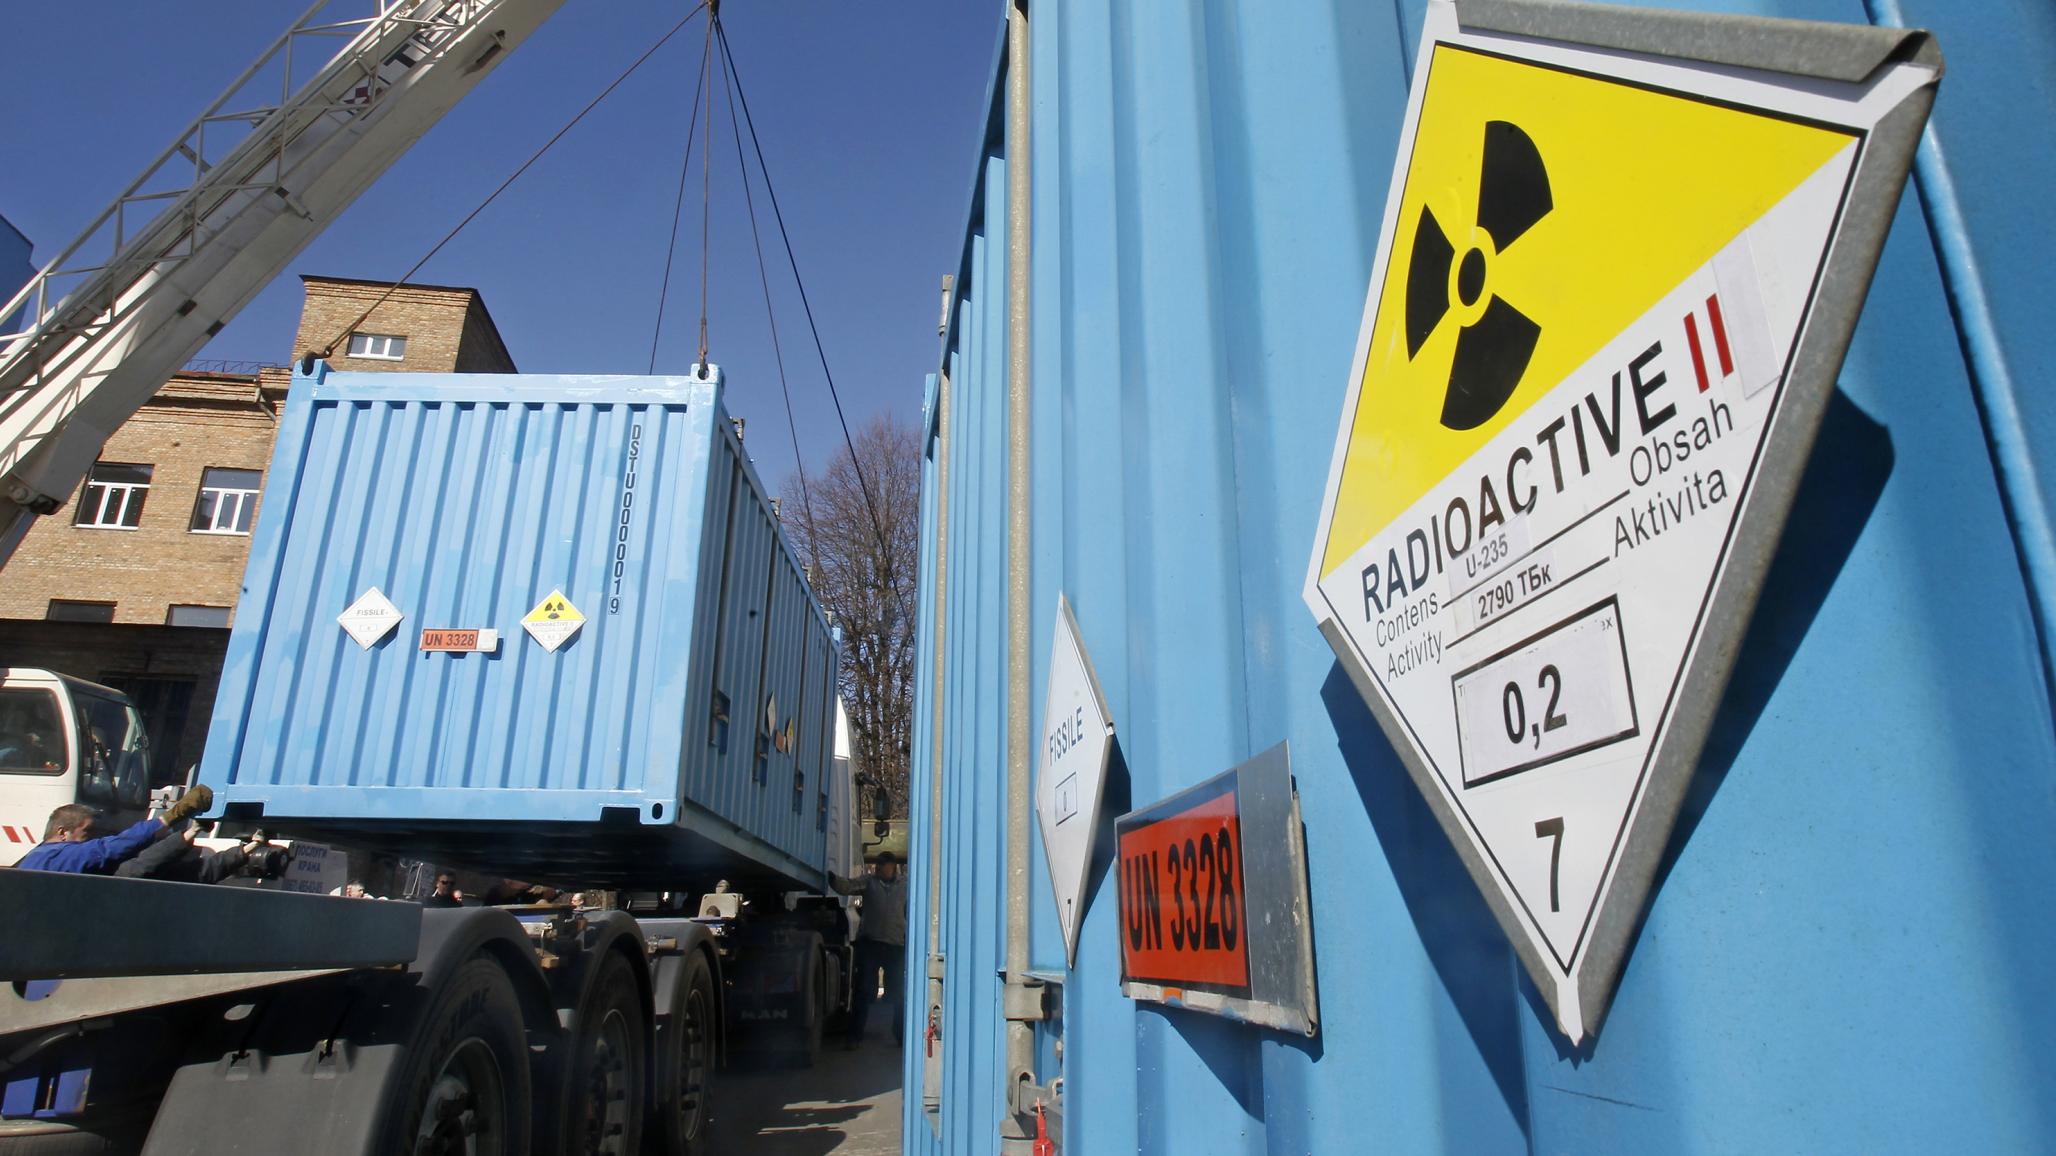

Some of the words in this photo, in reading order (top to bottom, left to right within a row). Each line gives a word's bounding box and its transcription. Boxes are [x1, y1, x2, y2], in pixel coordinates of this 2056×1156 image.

[1361, 339, 1677, 622] RADIOACTIVE
[1683, 293, 1734, 394] II
[1630, 398, 1733, 486] Obsah
[1614, 469, 1728, 558] Aktivita
[1465, 532, 1508, 578] U-235
[1376, 592, 1439, 648] Contens
[1478, 580, 1513, 620] 2790
[425, 633, 443, 646] UN
[446, 633, 475, 646] 3328
[1388, 631, 1442, 682] Activity
[1049, 706, 1083, 767] FISSILE
[1502, 663, 1567, 750] 0,2
[1125, 849, 1163, 952] UN
[1167, 826, 1237, 952] 3328
[1534, 816, 1565, 912] 7
